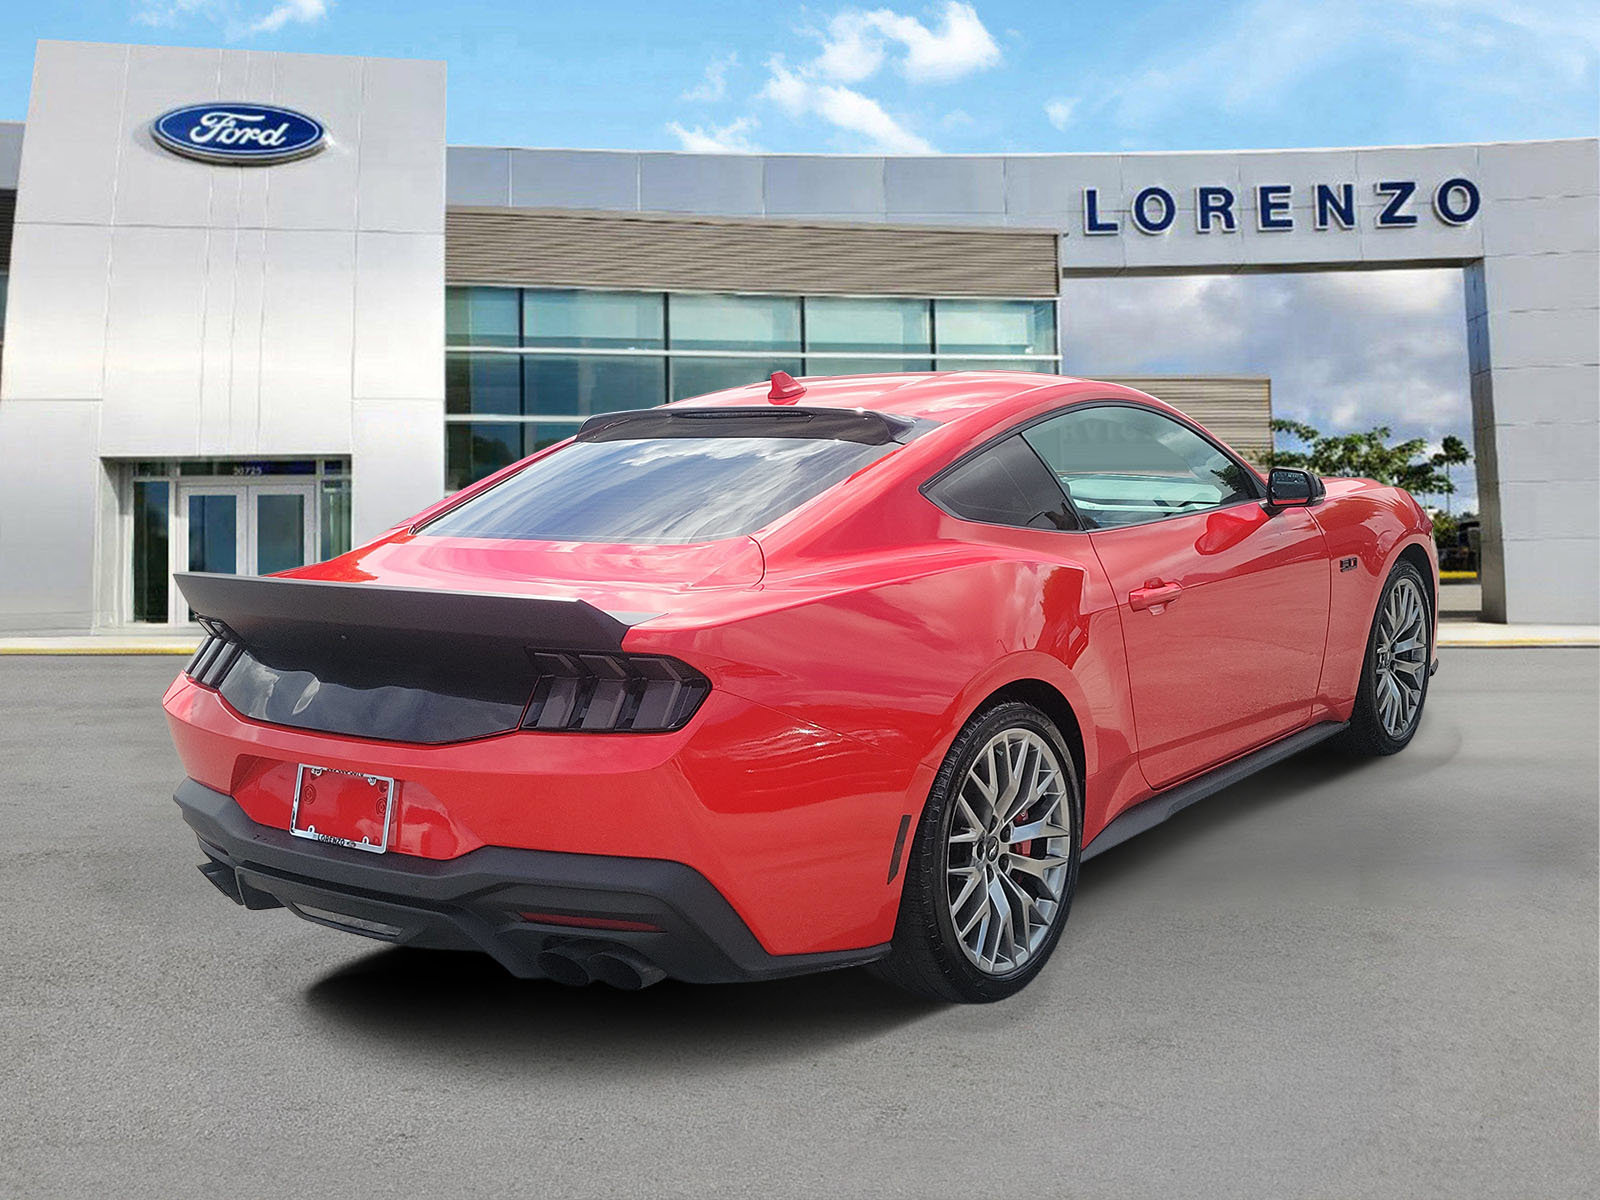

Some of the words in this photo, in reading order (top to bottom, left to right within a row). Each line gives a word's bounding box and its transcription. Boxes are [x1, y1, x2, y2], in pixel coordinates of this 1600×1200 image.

[189, 112, 289, 146] Ford
[1083, 178, 1481, 235] LORENZO
[318, 834, 346, 847] LORENZO
